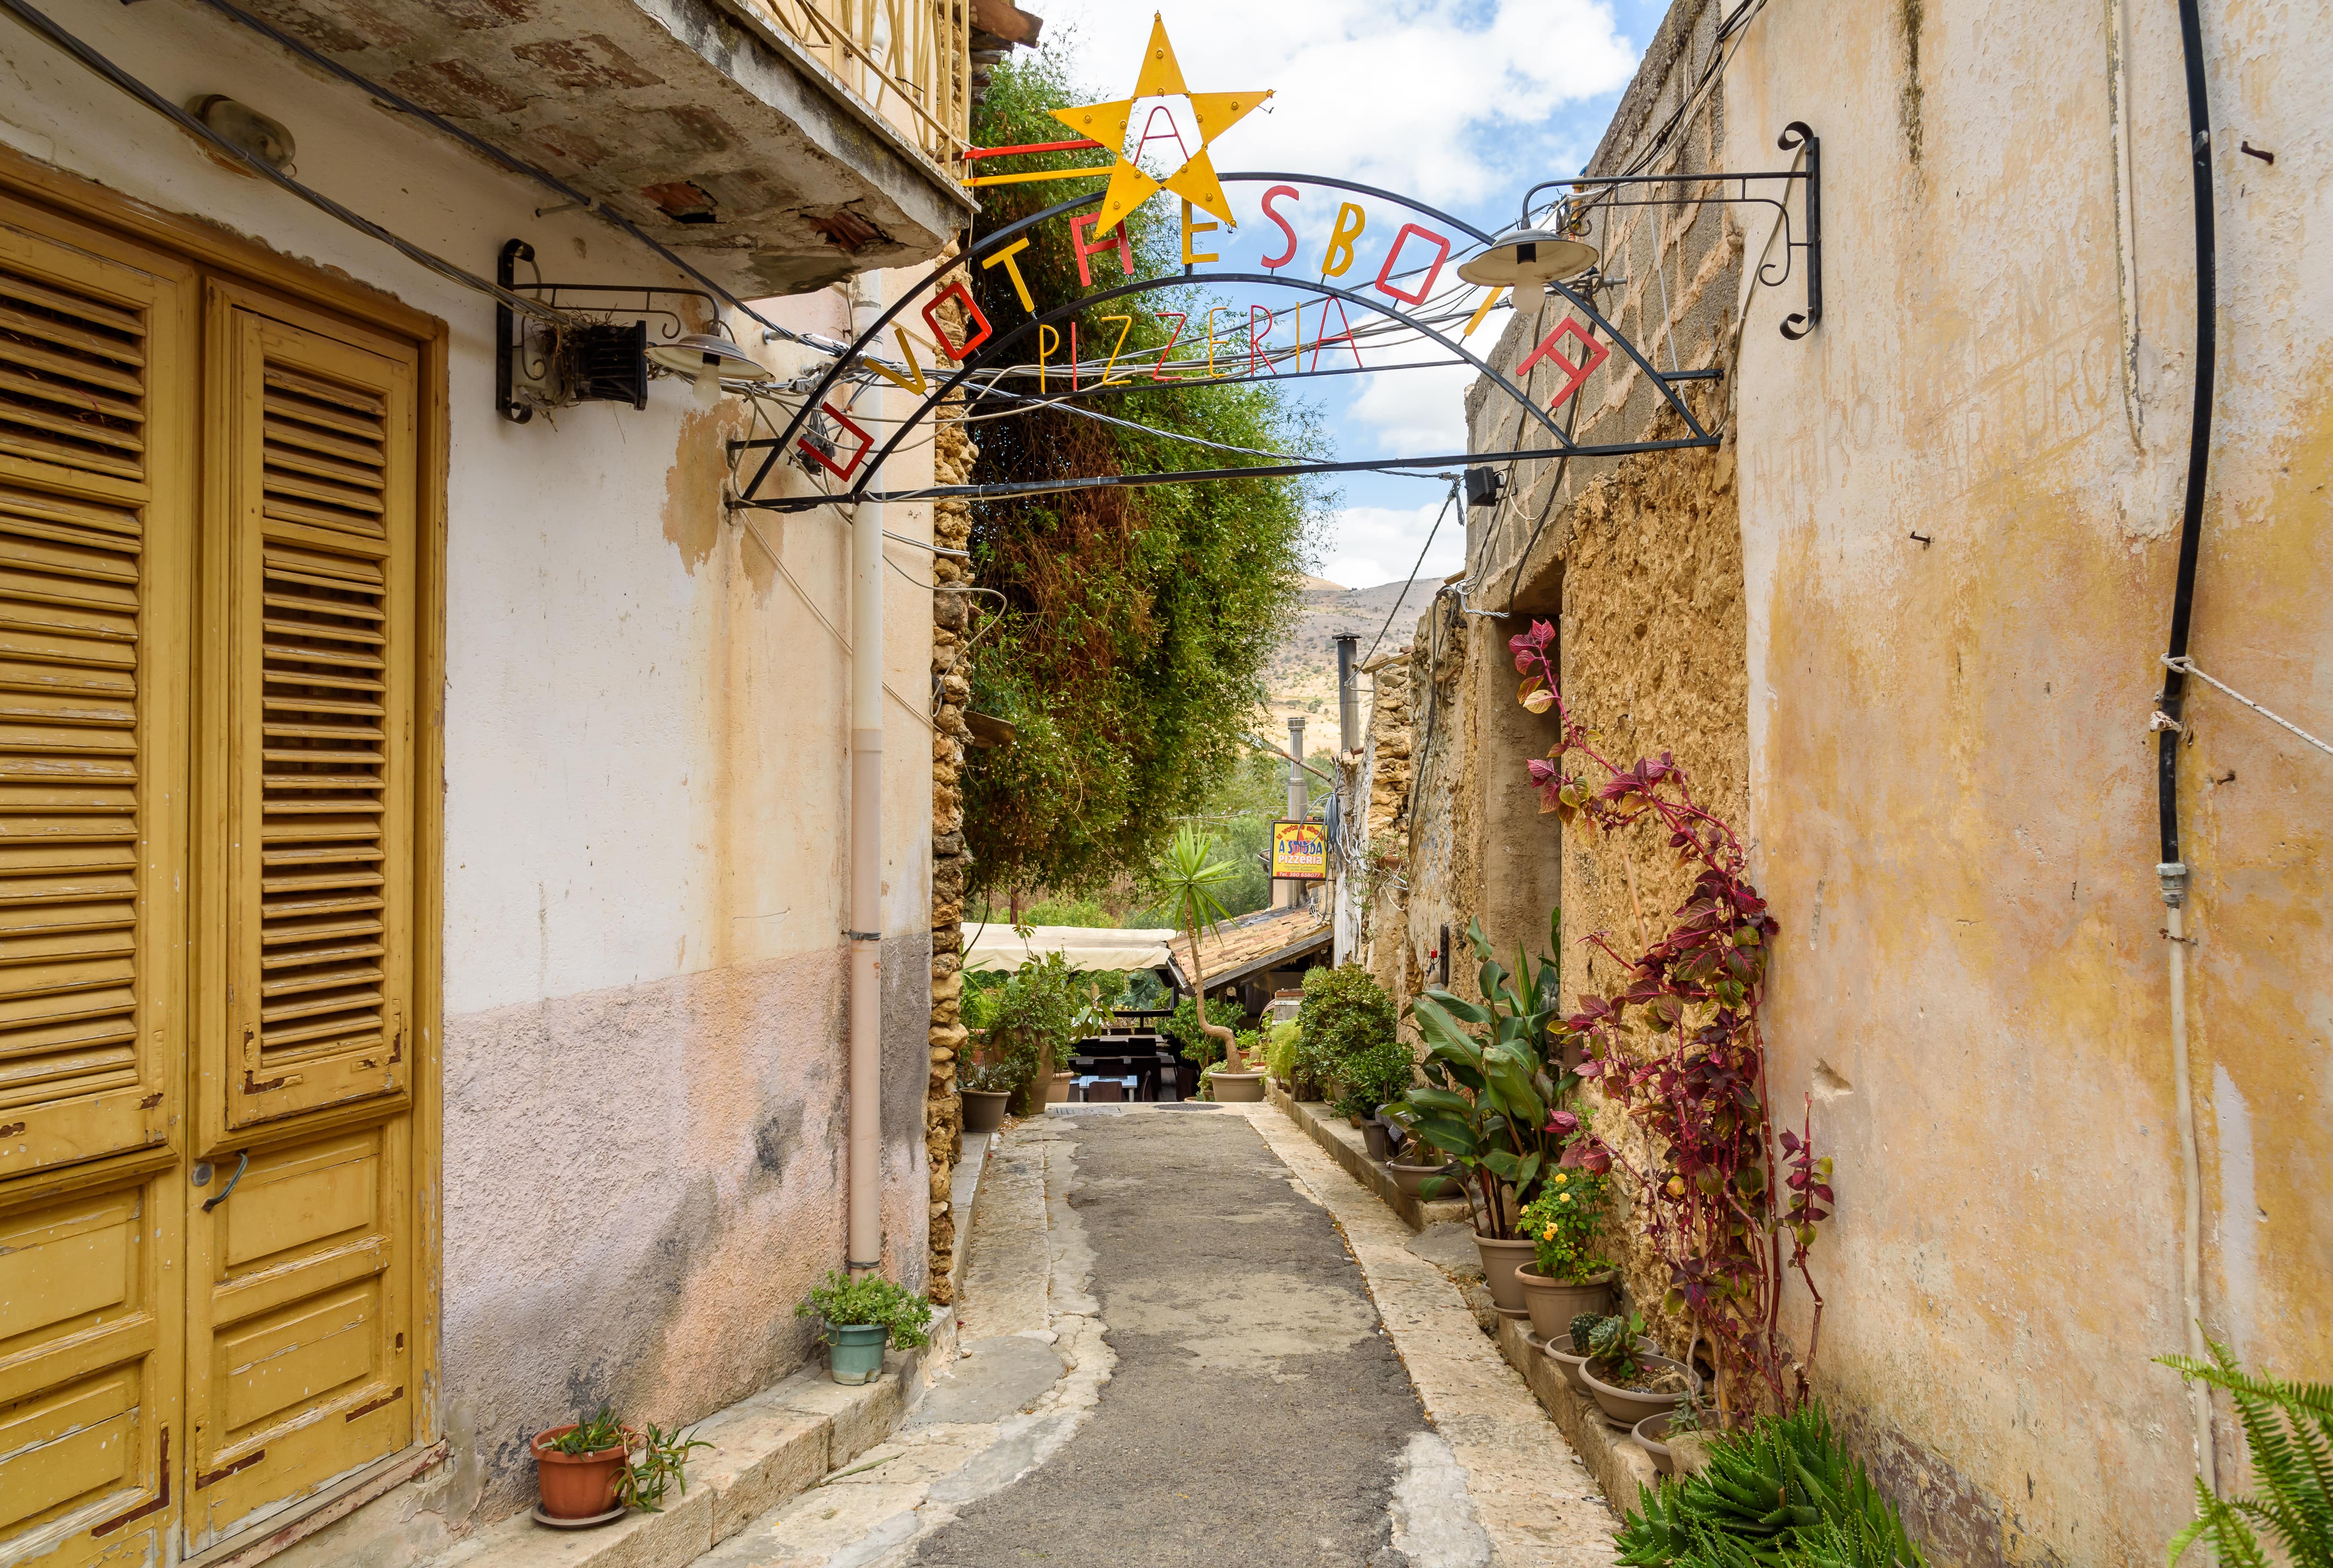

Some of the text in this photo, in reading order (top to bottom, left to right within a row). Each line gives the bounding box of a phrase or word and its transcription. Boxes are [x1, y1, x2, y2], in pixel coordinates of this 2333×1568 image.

[1133, 106, 1190, 166] A
[1040, 296, 1363, 394] PIZZERIA
[1279, 840, 1322, 855] A STIDDA
